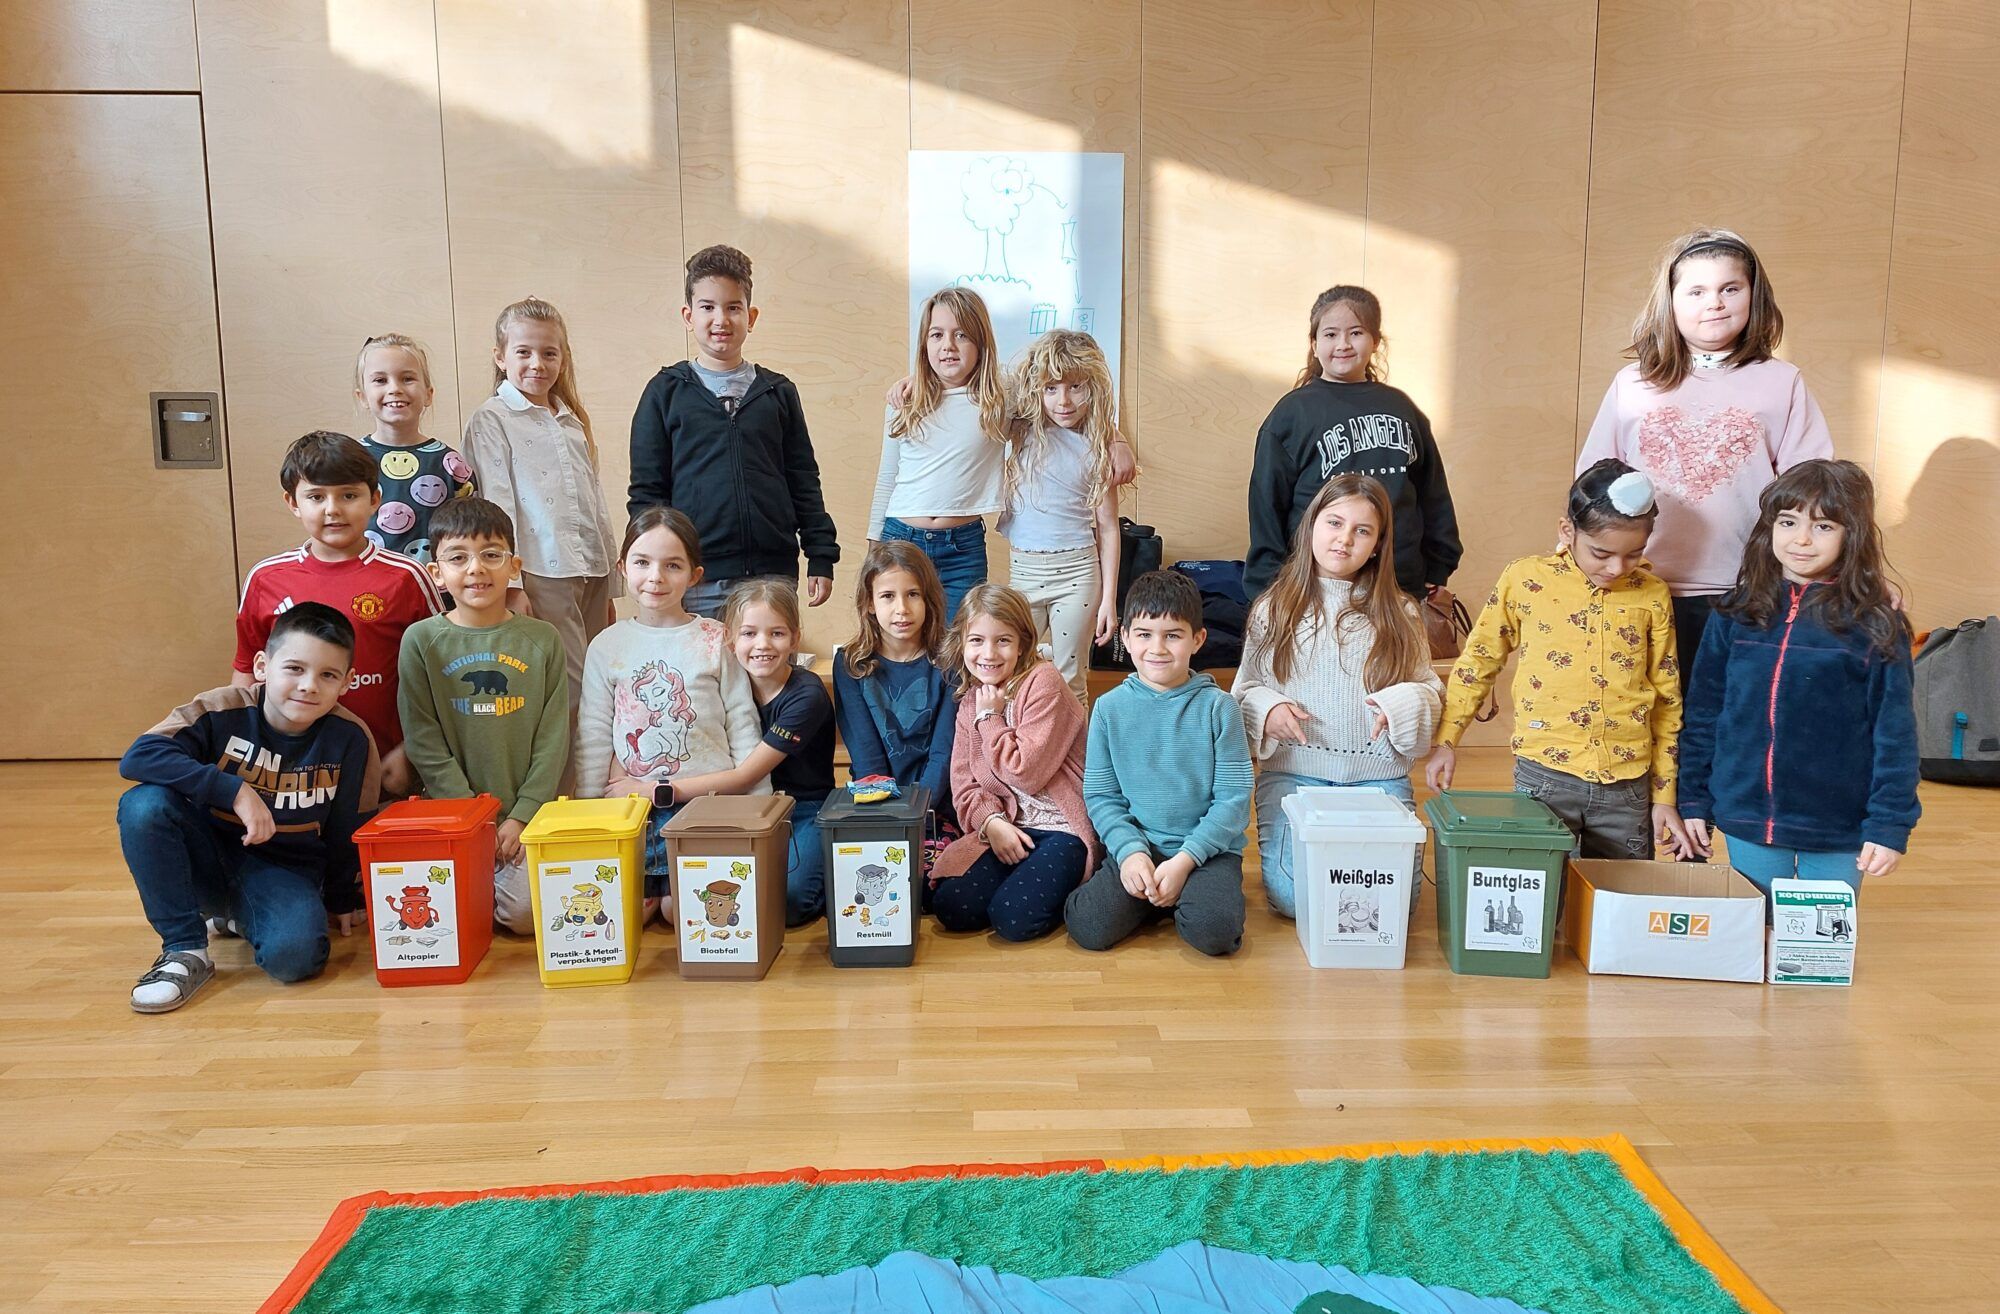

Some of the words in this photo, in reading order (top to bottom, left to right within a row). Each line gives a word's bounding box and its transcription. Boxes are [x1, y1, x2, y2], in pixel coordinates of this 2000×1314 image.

[1317, 424, 1351, 479] LOS
[442, 652, 496, 676] NATIONAL
[498, 653, 529, 674] PARK
[451, 698, 470, 715] THE
[473, 704, 495, 714] BLACK
[495, 697, 525, 717] BEAR
[217, 736, 282, 790] FUN
[274, 768, 340, 810] RUN
[1329, 868, 1394, 889] Weißglas
[1473, 871, 1541, 893] Buntglas
[1778, 892, 1851, 903] Sammelbox
[1649, 913, 1709, 935] ASZ
[857, 931, 892, 939] Restmüll
[397, 953, 440, 962] Altpapier
[550, 949, 583, 959] Plastik-
[592, 947, 623, 956] Metall-
[557, 955, 617, 966] verpackungen
